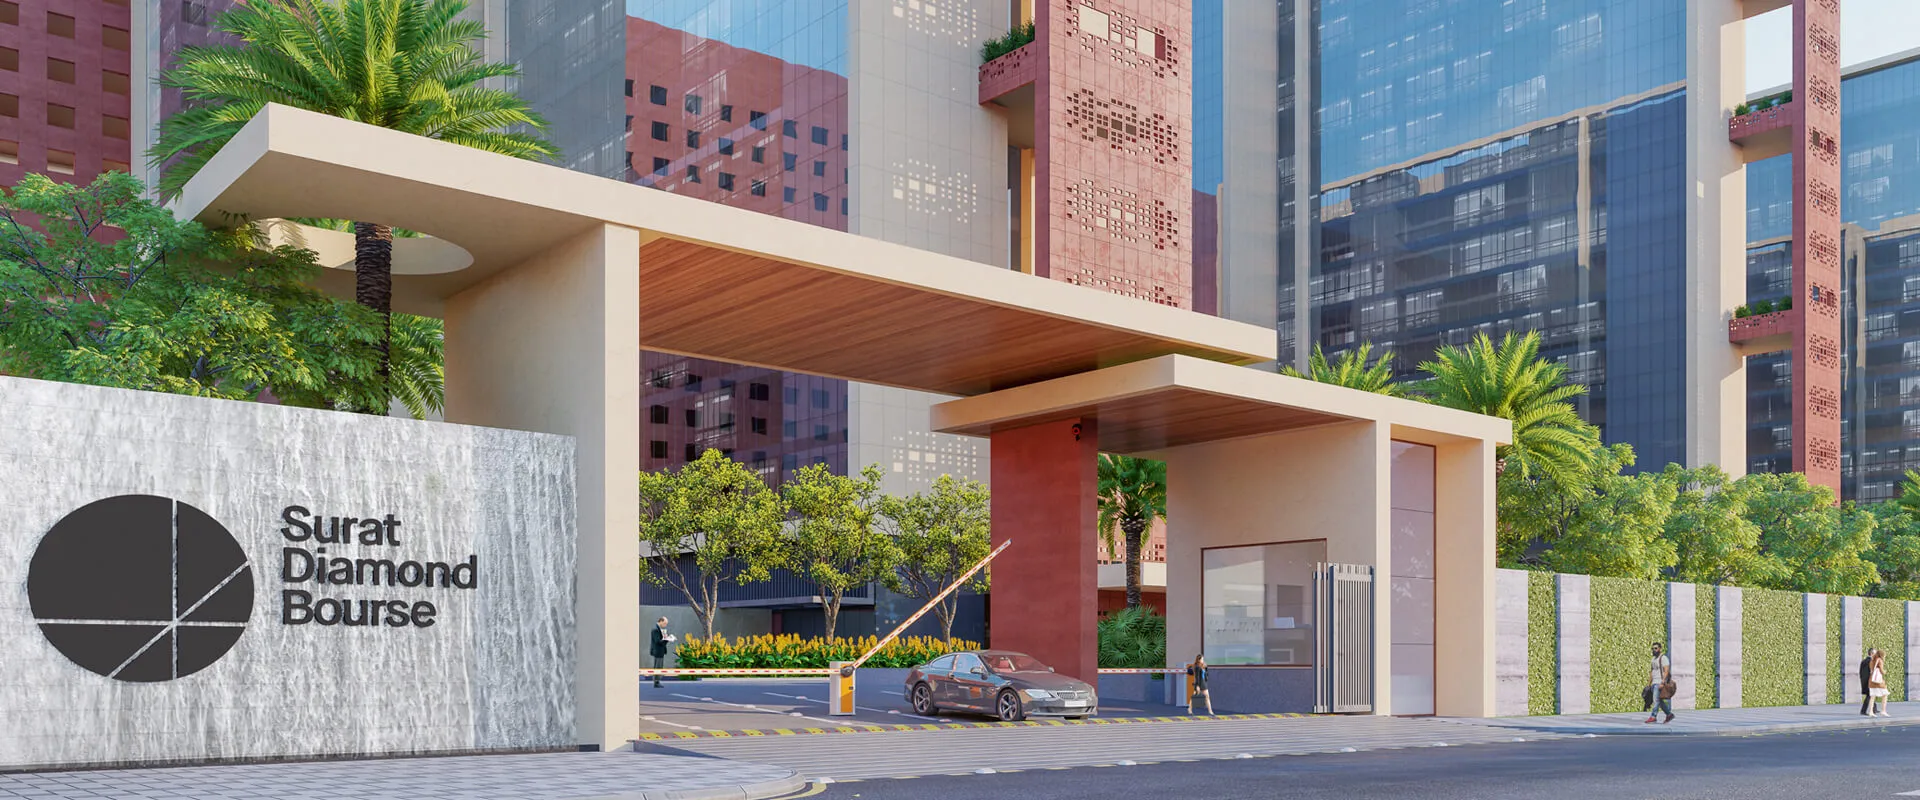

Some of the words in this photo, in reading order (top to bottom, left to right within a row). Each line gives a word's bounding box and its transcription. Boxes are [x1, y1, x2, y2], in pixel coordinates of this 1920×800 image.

[281, 505, 401, 547] Surat
[281, 546, 478, 590] Diamond
[281, 589, 437, 628] Bourse
